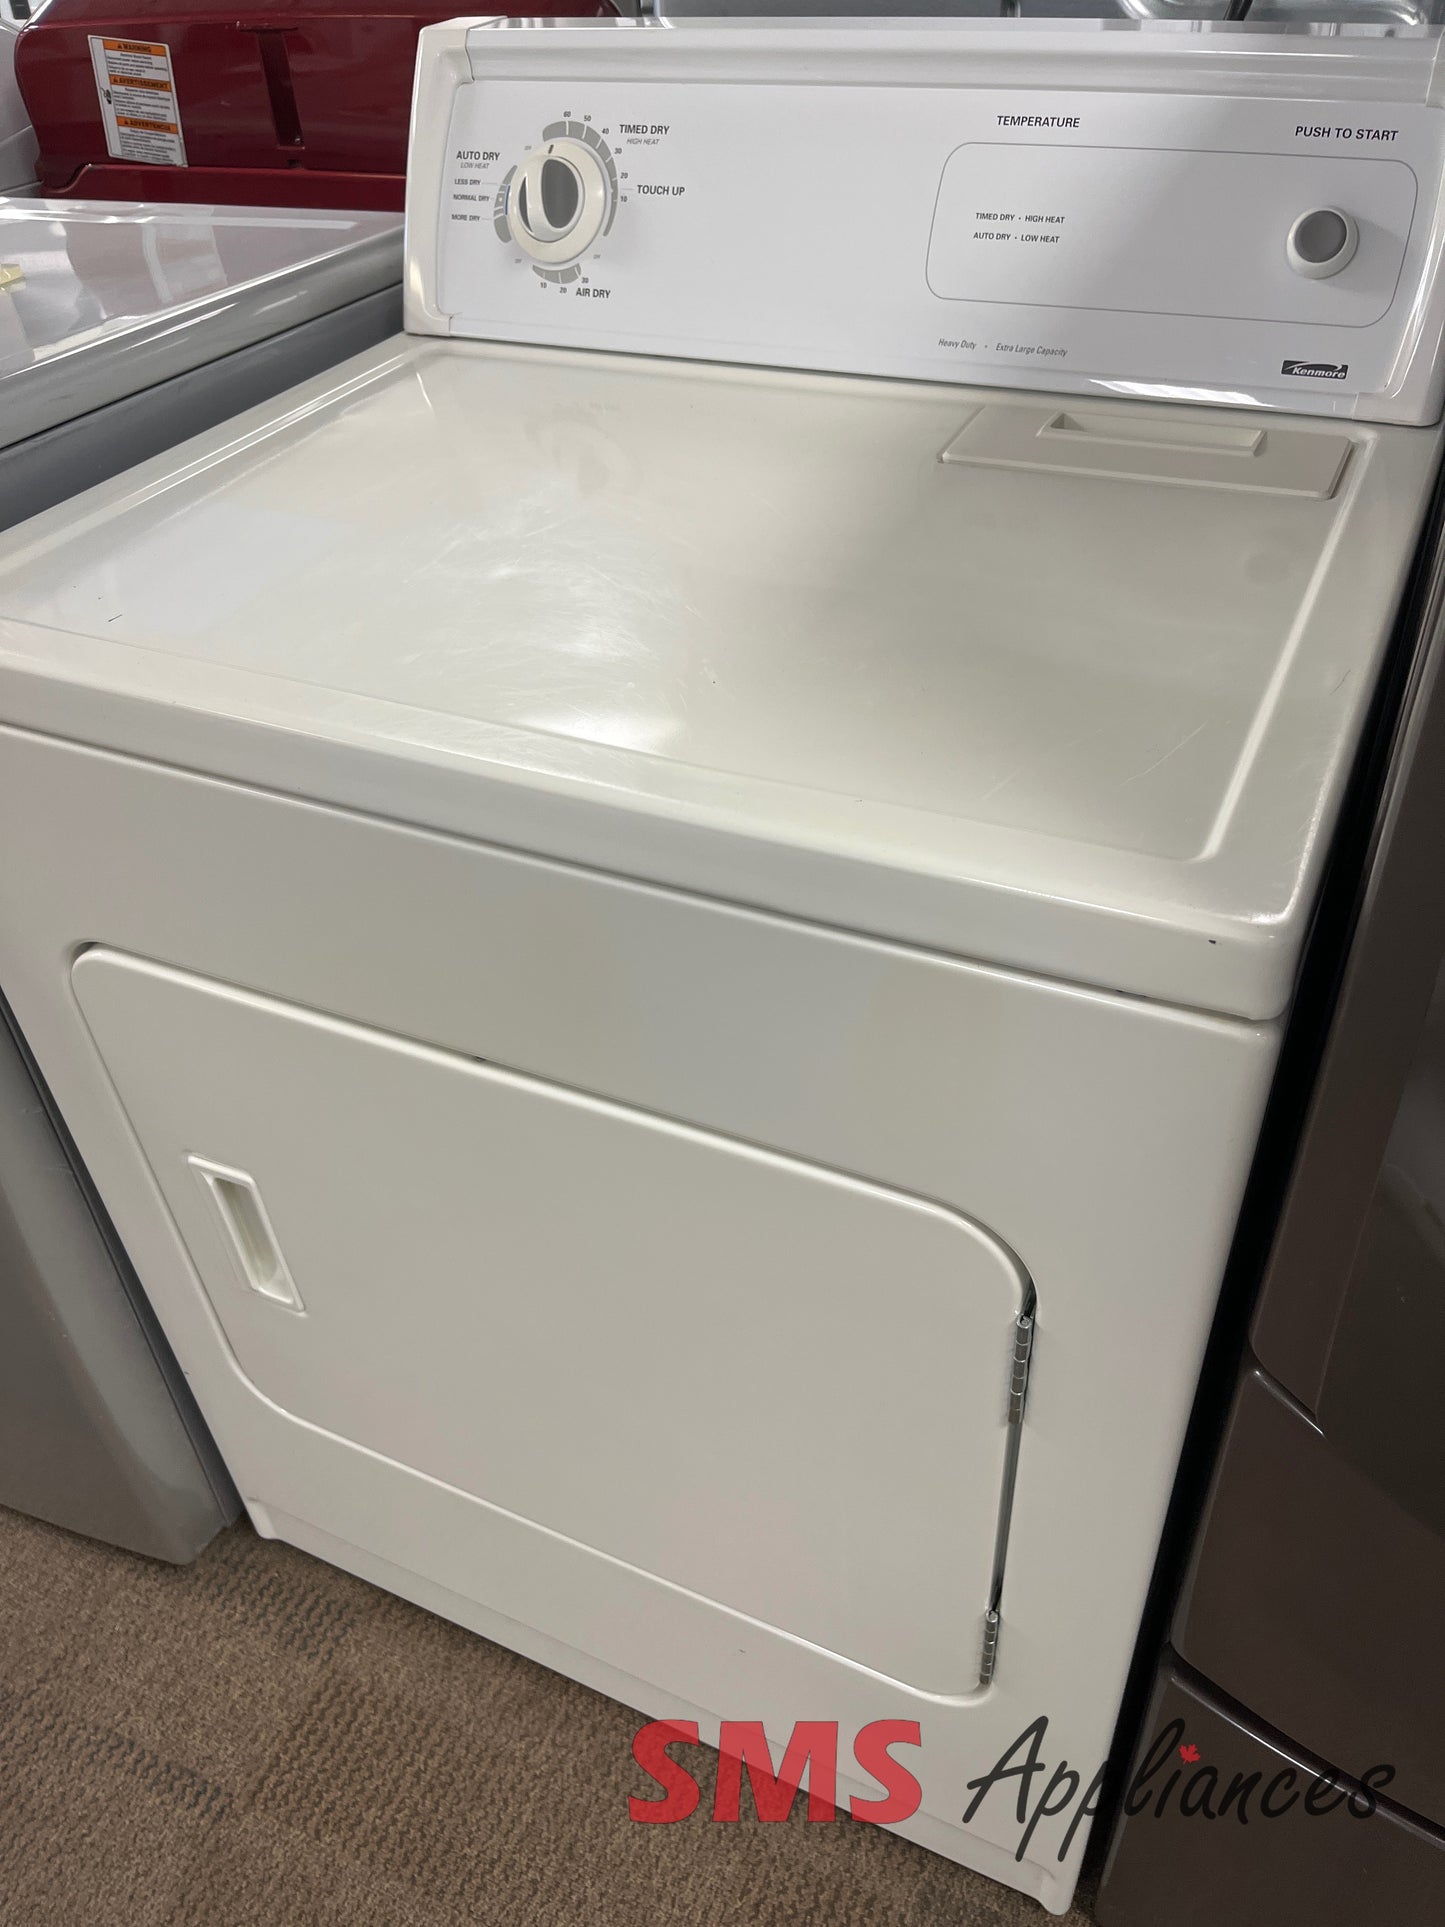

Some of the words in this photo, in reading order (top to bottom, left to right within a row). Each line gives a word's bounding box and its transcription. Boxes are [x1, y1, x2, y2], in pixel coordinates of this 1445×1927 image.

[997, 115, 1081, 128] TEMPERATURE
[619, 124, 648, 134] TIMED
[650, 125, 670, 135] DRY
[1295, 125, 1331, 138] PUSH
[1335, 127, 1352, 139] TO
[1355, 128, 1399, 141] START
[456, 150, 480, 160] AUTO
[482, 151, 501, 161] DRY
[614, 147, 622, 155] 30
[474, 162, 490, 170] HEAT
[454, 178, 468, 186] LESS
[637, 184, 670, 196] TOUCH
[672, 186, 686, 196] UP
[453, 193, 477, 202] NORMAL
[451, 213, 468, 221] MORE
[976, 212, 998, 221] TIMED
[999, 213, 1015, 222] DRY
[1025, 214, 1044, 223] HIGH
[1045, 215, 1065, 224] HEAT
[973, 231, 995, 240] AUTO
[995, 232, 1011, 241] DRY
[1020, 234, 1039, 242] LOW
[1039, 235, 1060, 244] HEAT
[576, 287, 591, 297] AIR
[592, 289, 611, 299] DRY
[938, 338, 960, 349] Heavy
[960, 339, 977, 350] Duty
[995, 342, 1014, 352] Extra
[1015, 344, 1035, 355] Large
[1036, 345, 1068, 358] Capacity
[1292, 366, 1346, 379] Kenmore
